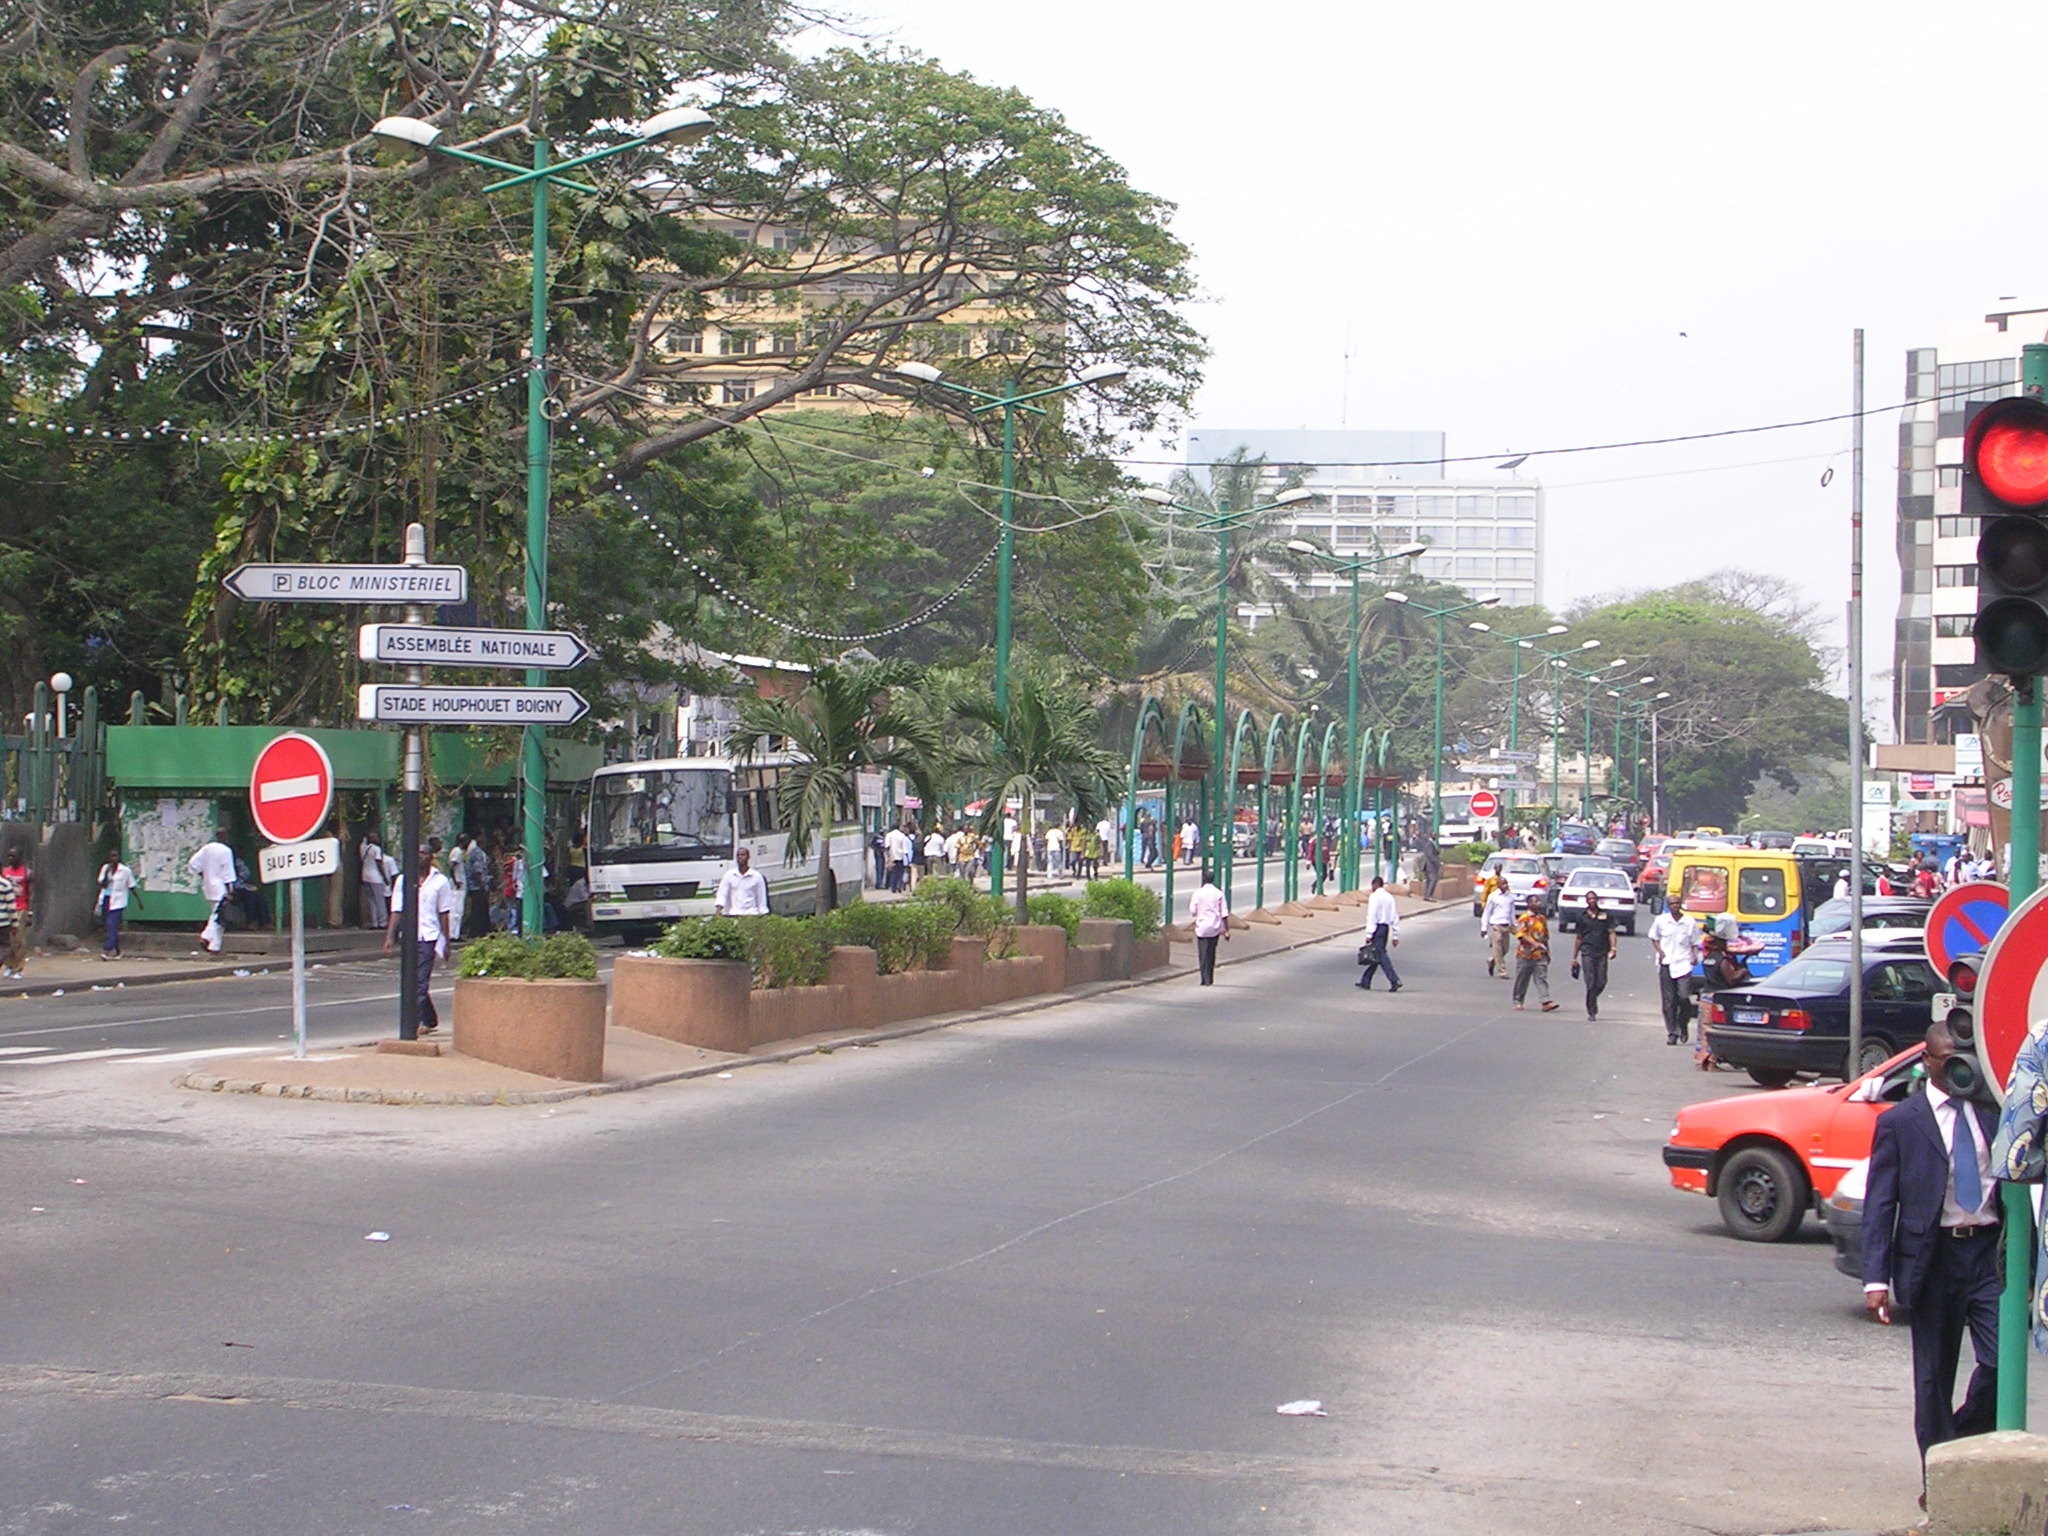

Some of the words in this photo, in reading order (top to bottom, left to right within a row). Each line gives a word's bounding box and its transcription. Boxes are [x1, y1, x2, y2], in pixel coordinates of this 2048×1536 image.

[297, 576, 341, 590] BLOC
[350, 576, 453, 592] MINISTERIEL
[386, 636, 472, 654] ASSEMBLÉE
[481, 641, 556, 656] NATIONALE
[383, 697, 426, 712] STADE
[432, 698, 511, 713] HOUPHOUET
[516, 699, 563, 713] BOIGNY
[266, 853, 294, 872] SAUF
[300, 850, 326, 866] BUS
